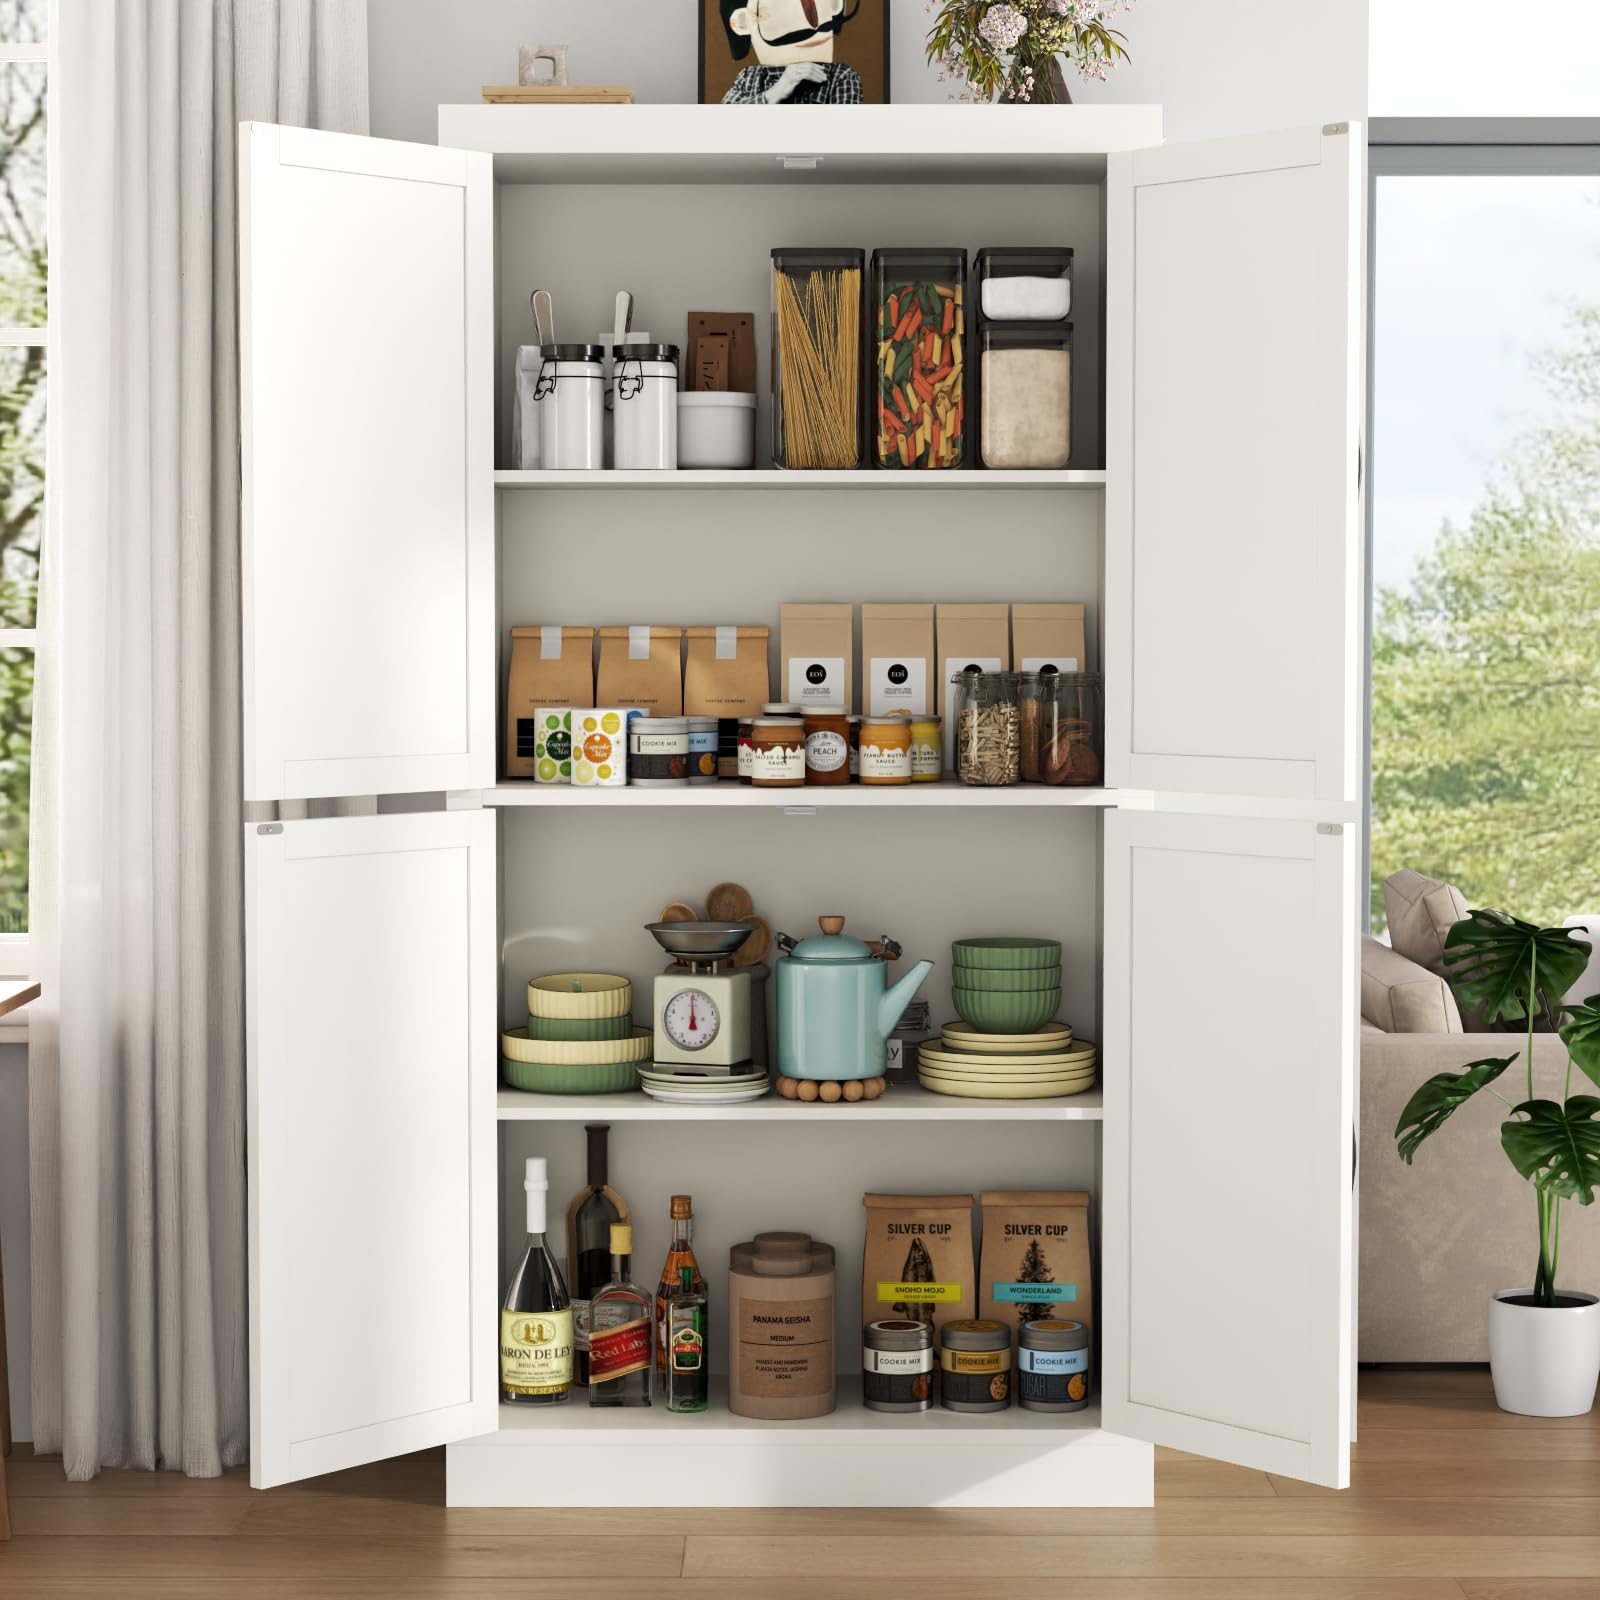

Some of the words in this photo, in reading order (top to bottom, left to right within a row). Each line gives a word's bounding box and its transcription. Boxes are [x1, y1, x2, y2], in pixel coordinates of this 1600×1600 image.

[888, 1223, 925, 1235] SILVER
[928, 1223, 952, 1235] CUP
[1004, 1224, 1042, 1235] SILVER
[1045, 1225, 1068, 1236] CUP
[895, 1286, 922, 1294] SNOHO
[752, 1315, 783, 1324] PANAMA
[784, 1315, 811, 1324] GEISHA
[534, 1349, 552, 1360] DE
[555, 1345, 571, 1358] LEY
[590, 1346, 619, 1362] Red
[621, 1339, 647, 1352] Lab
